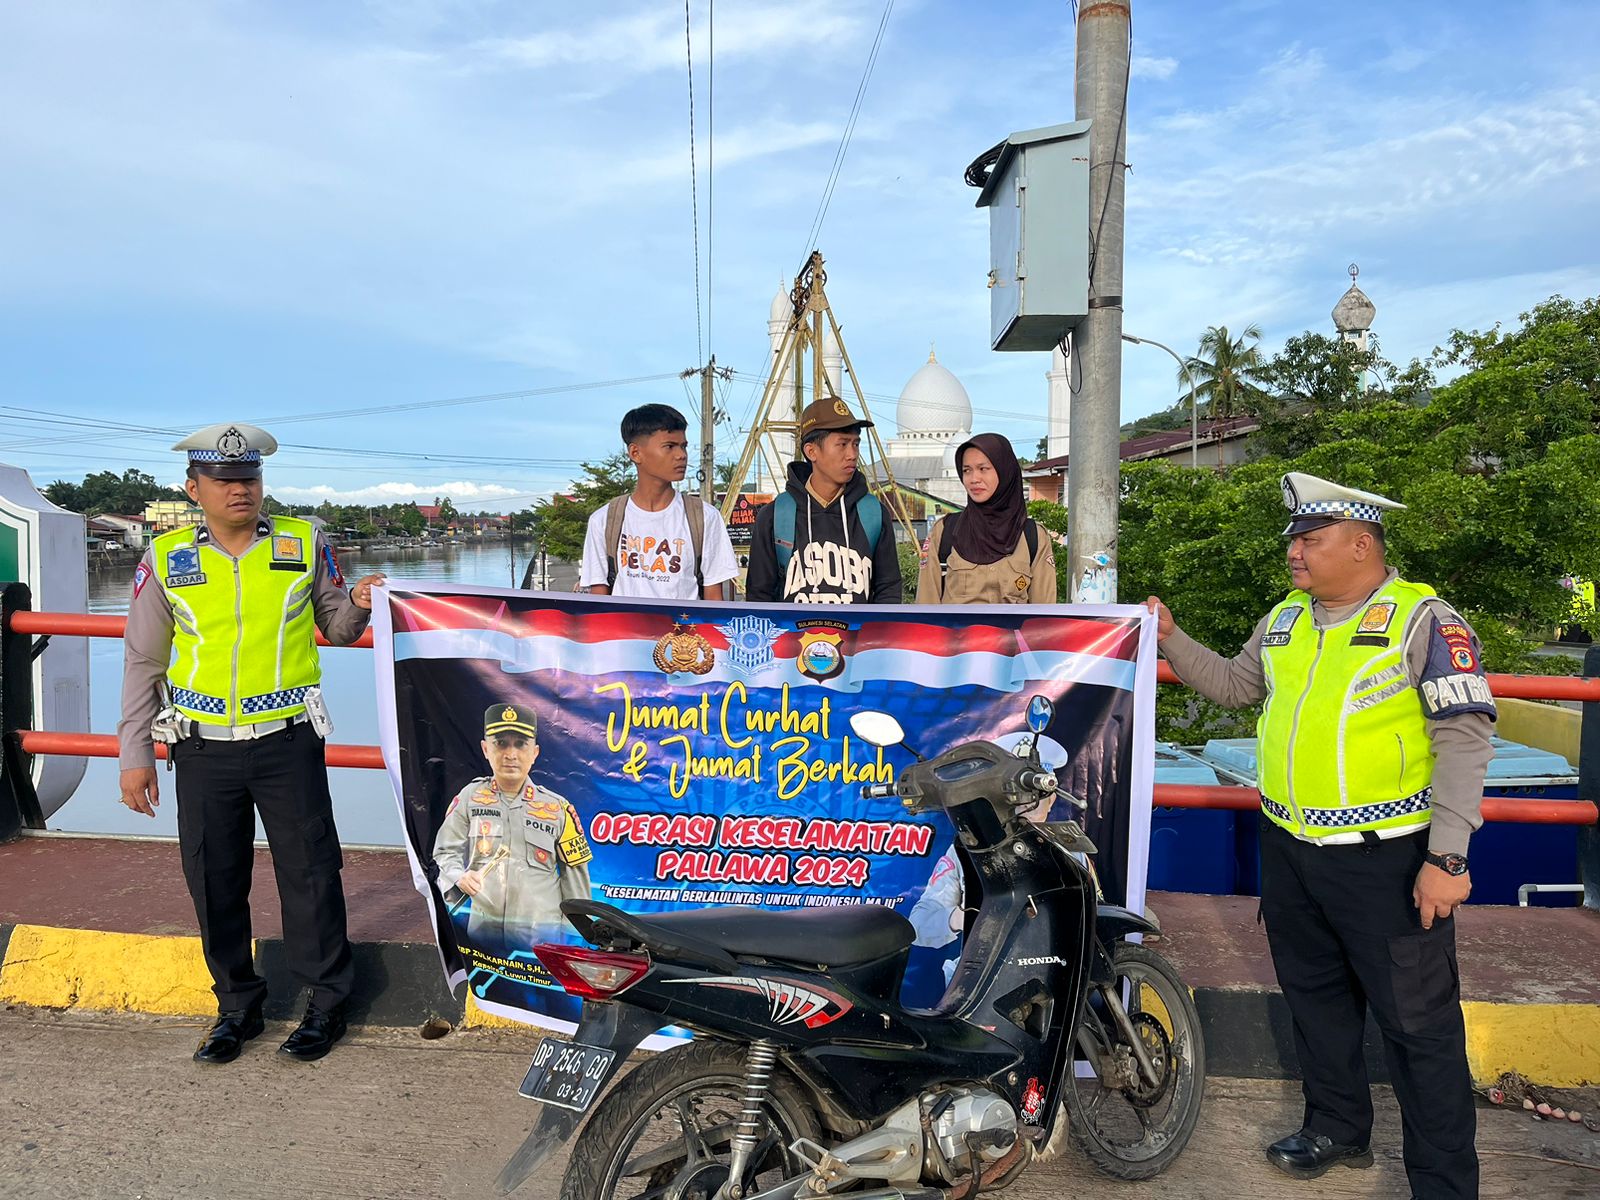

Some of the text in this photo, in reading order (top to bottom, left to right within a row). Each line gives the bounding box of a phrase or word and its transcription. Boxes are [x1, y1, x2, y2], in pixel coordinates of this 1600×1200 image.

[824, 620, 847, 629] SELATAN
[594, 680, 831, 752] Jumat Curhat
[622, 735, 893, 800] & Jumat Berkah
[526, 819, 554, 835] POLRI
[590, 812, 932, 855] OPERASI KESELAMATAN
[656, 851, 870, 887] PALLAWA 2024
[765, 893, 801, 905] UNTUK
[473, 960, 551, 986] Kapolres Luwu Timur
[1018, 956, 1061, 966] HONDA
[533, 1043, 554, 1067] DP
[552, 1048, 585, 1075] 2546
